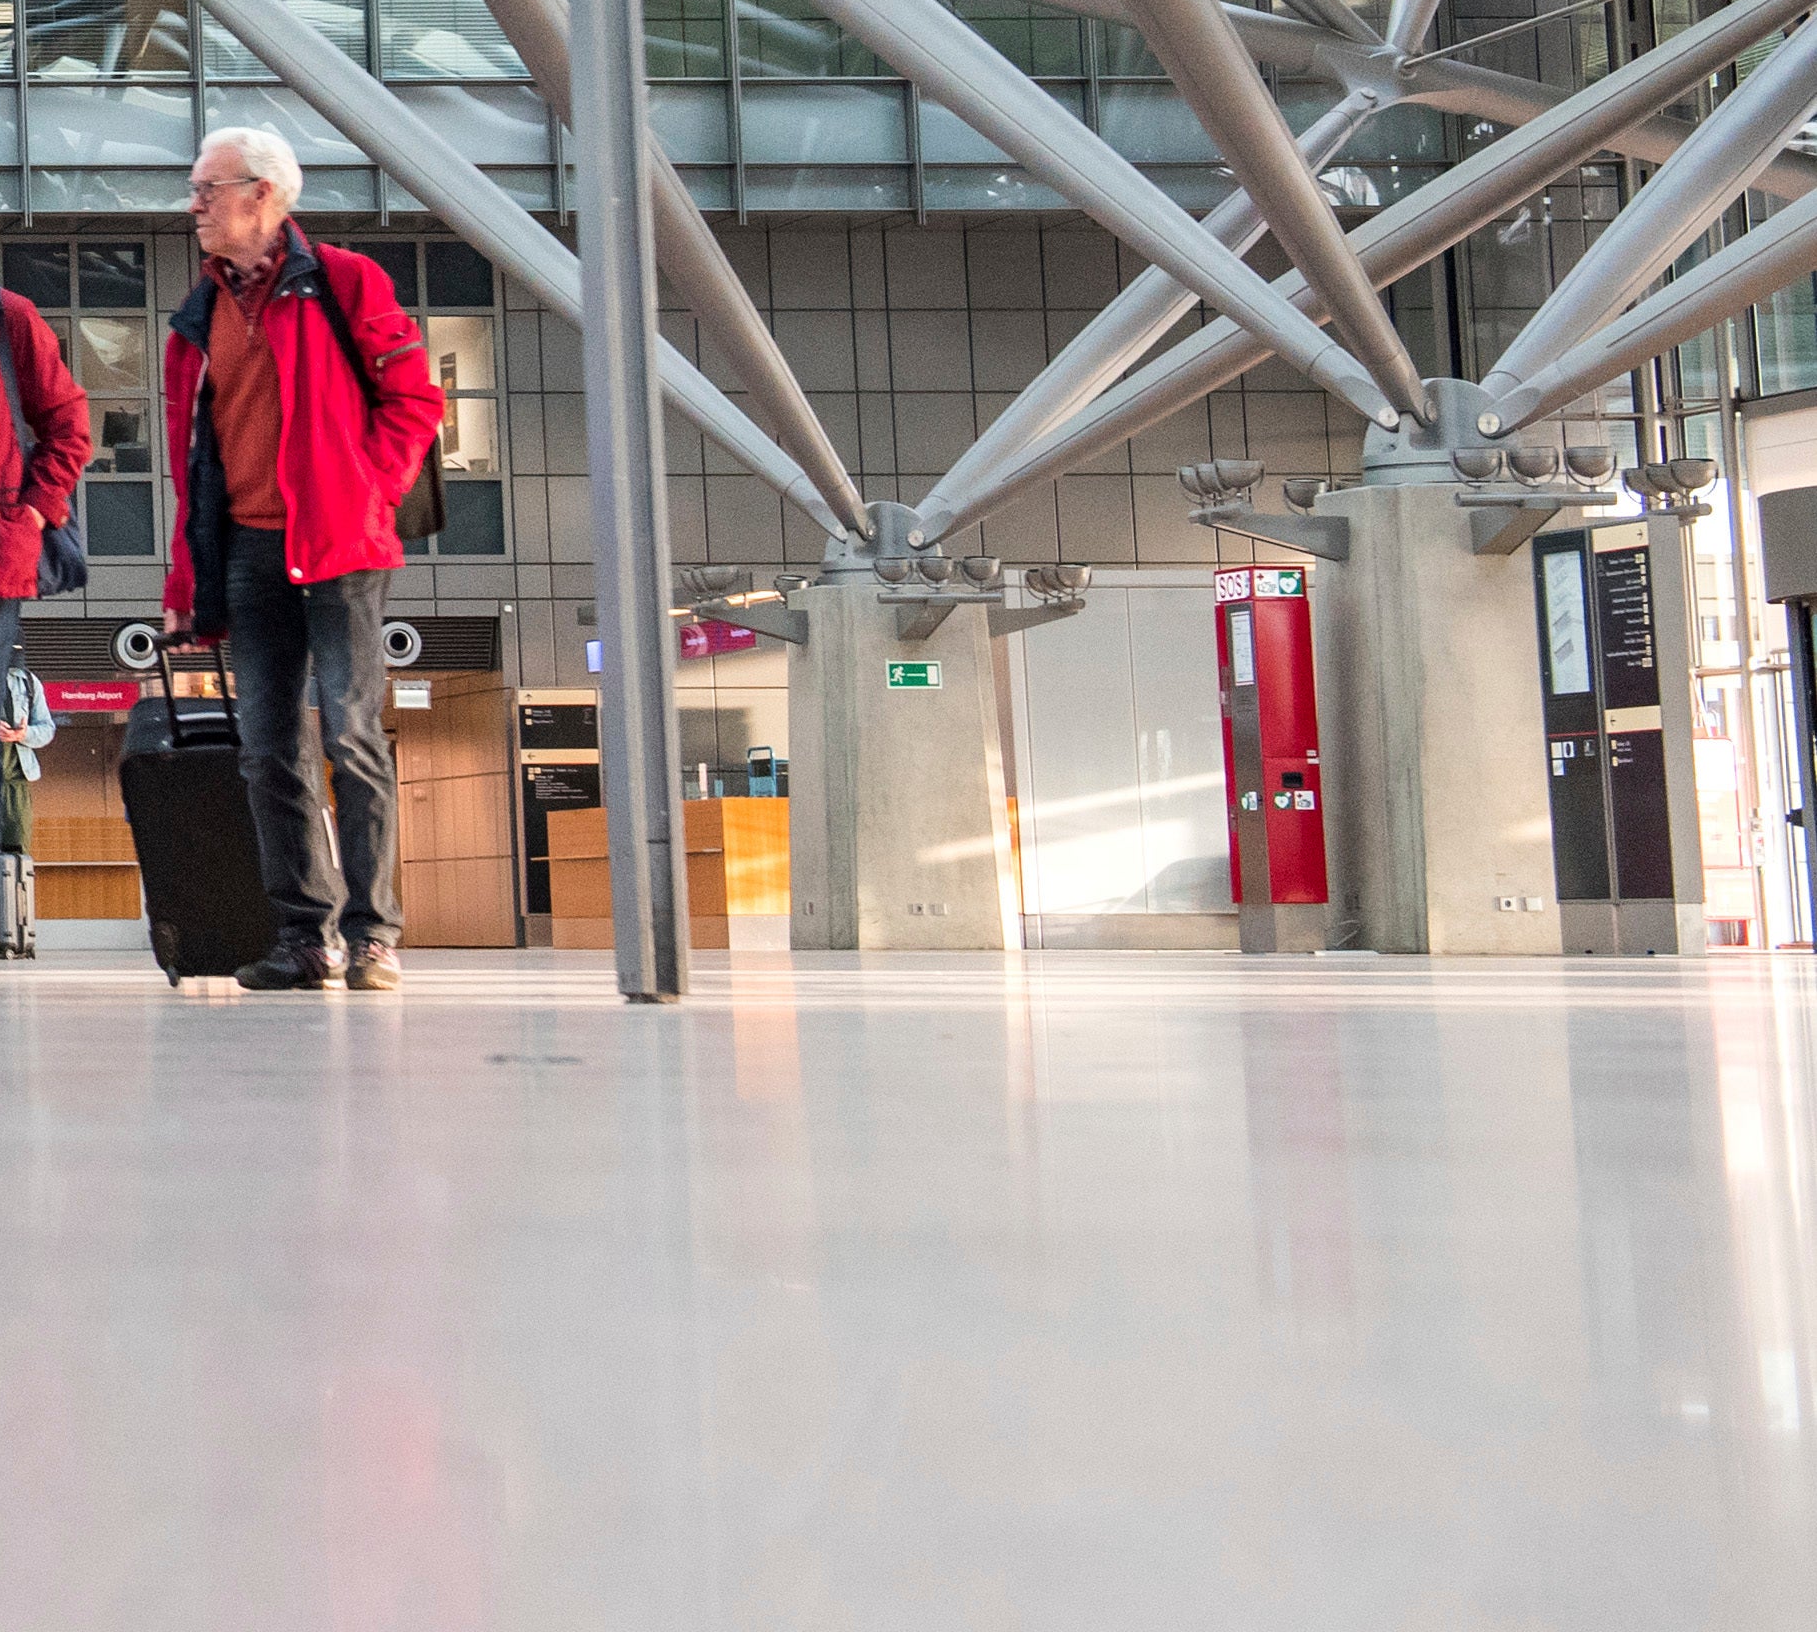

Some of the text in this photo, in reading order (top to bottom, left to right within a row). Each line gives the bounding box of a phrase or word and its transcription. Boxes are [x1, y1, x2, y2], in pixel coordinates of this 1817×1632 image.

[1219, 574, 1243, 598] SOS
[62, 692, 123, 700] Hamburg Airport
